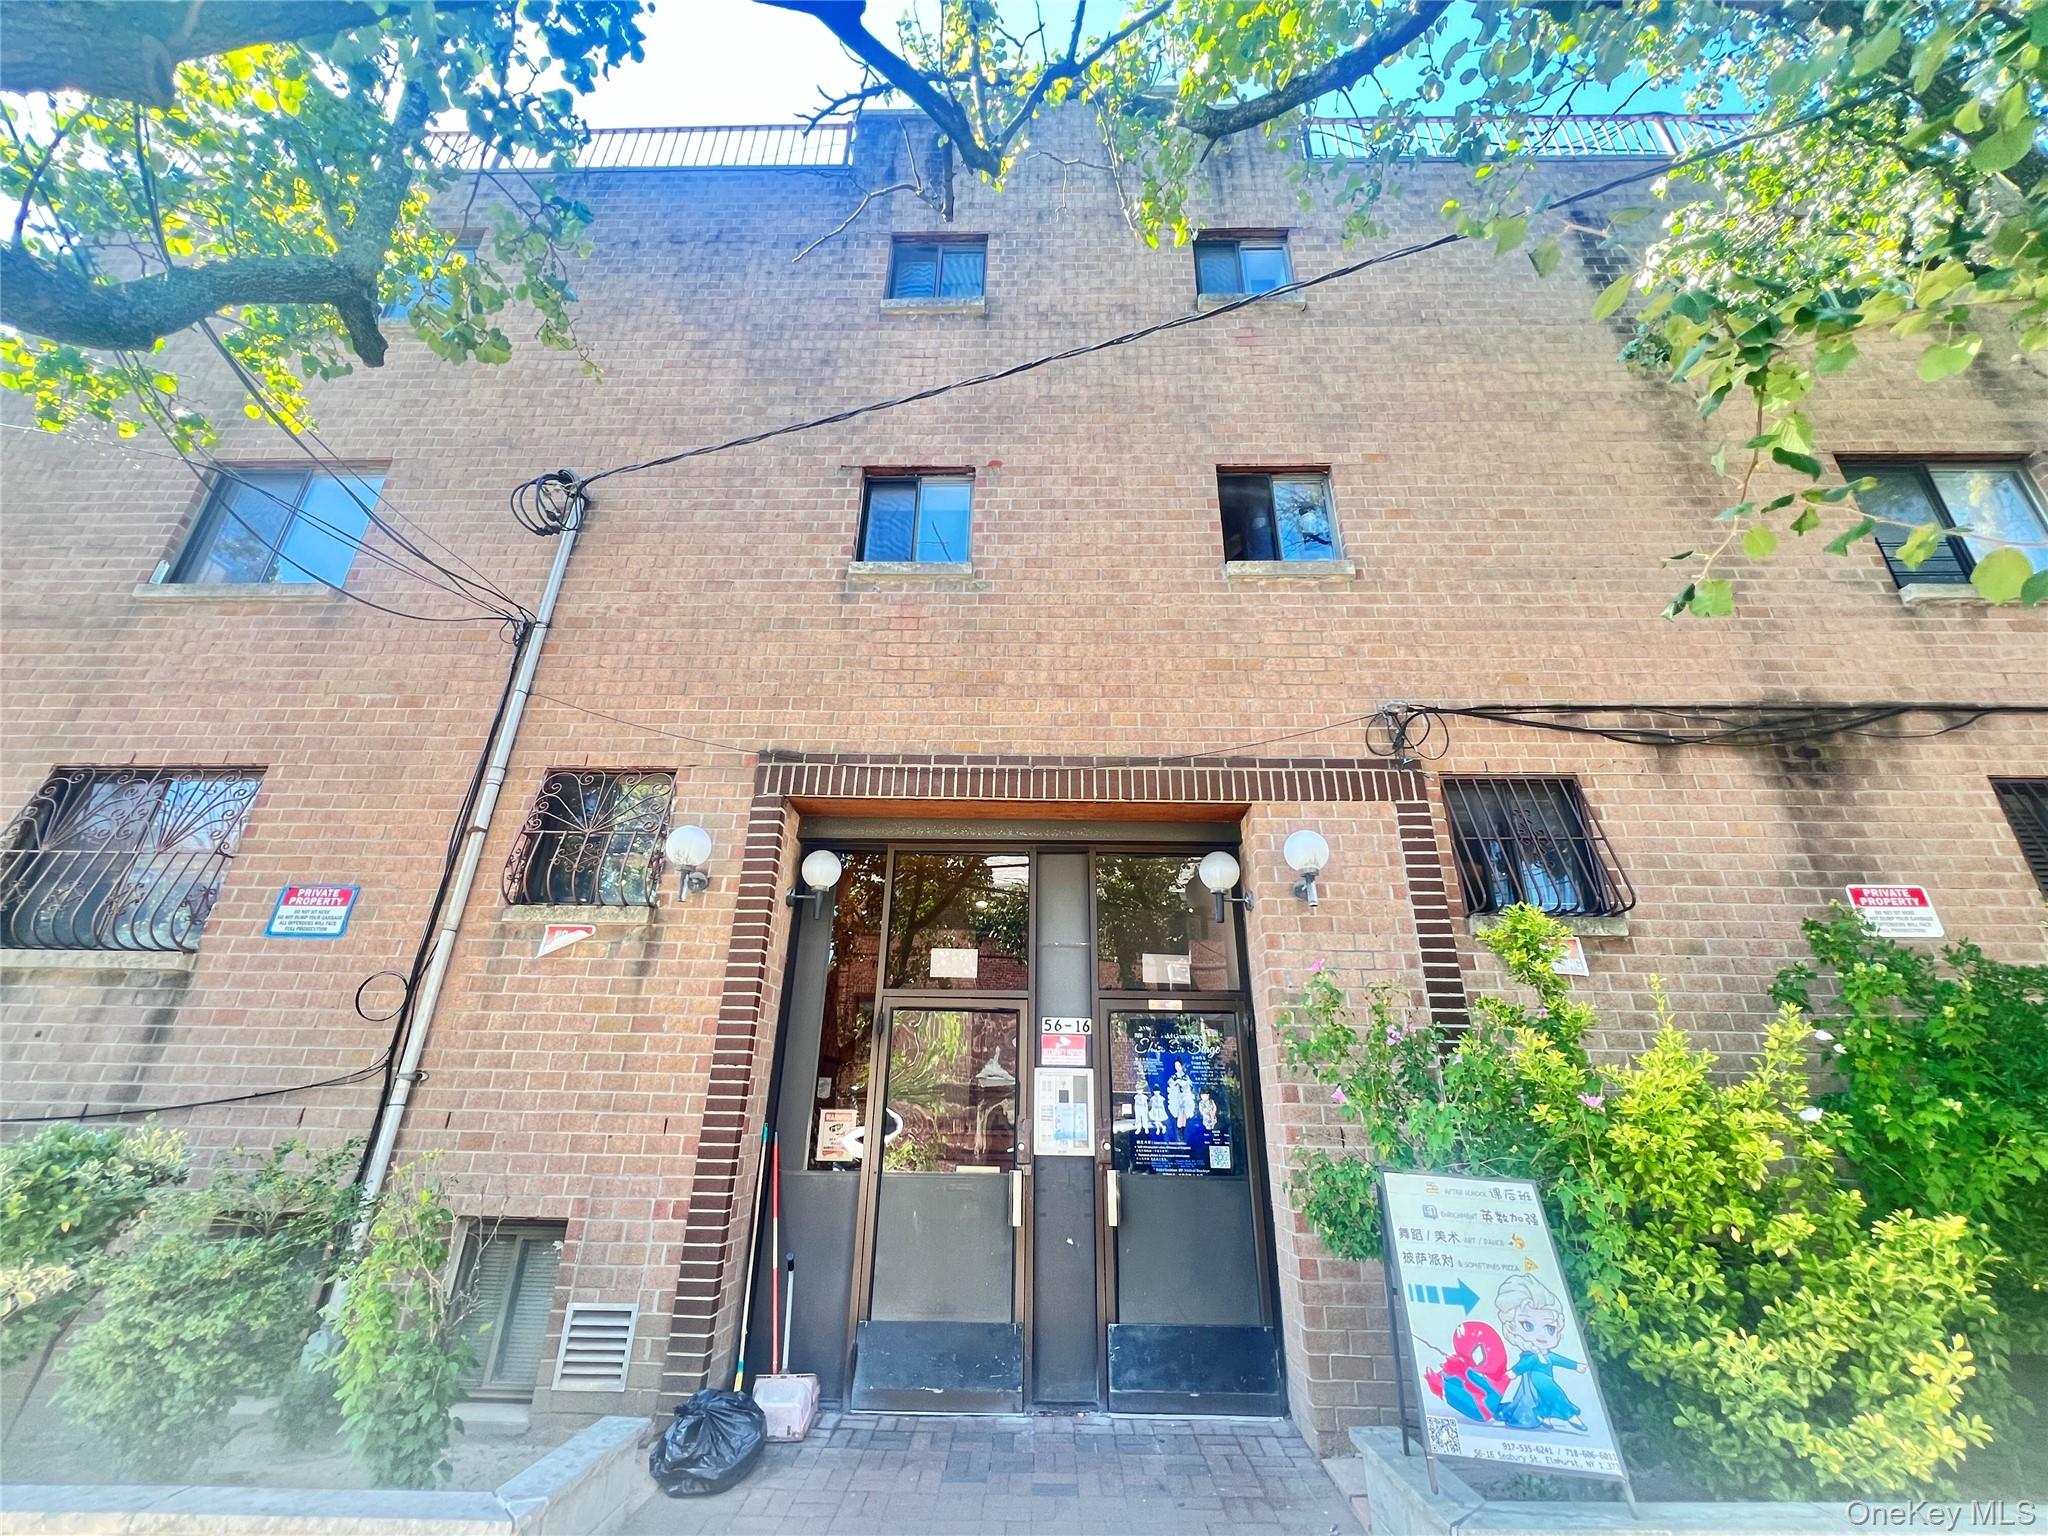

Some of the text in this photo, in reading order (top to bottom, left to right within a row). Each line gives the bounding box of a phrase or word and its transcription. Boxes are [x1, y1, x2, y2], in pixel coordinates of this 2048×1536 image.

[297, 888, 341, 897] PRIVATE
[1862, 889, 1911, 897] PRIVATE
[288, 896, 344, 906] PROPERTY
[1859, 897, 1920, 906] PROPERTY
[1043, 1018, 1090, 1033] 56-16
[1489, 1187, 1532, 1201] 课后班
[1480, 1208, 1539, 1225] 英数加强
[1398, 1227, 1423, 1241] 舞蹈
[1434, 1230, 1461, 1244] 美术
[1402, 1251, 1454, 1268] 披萨派对
